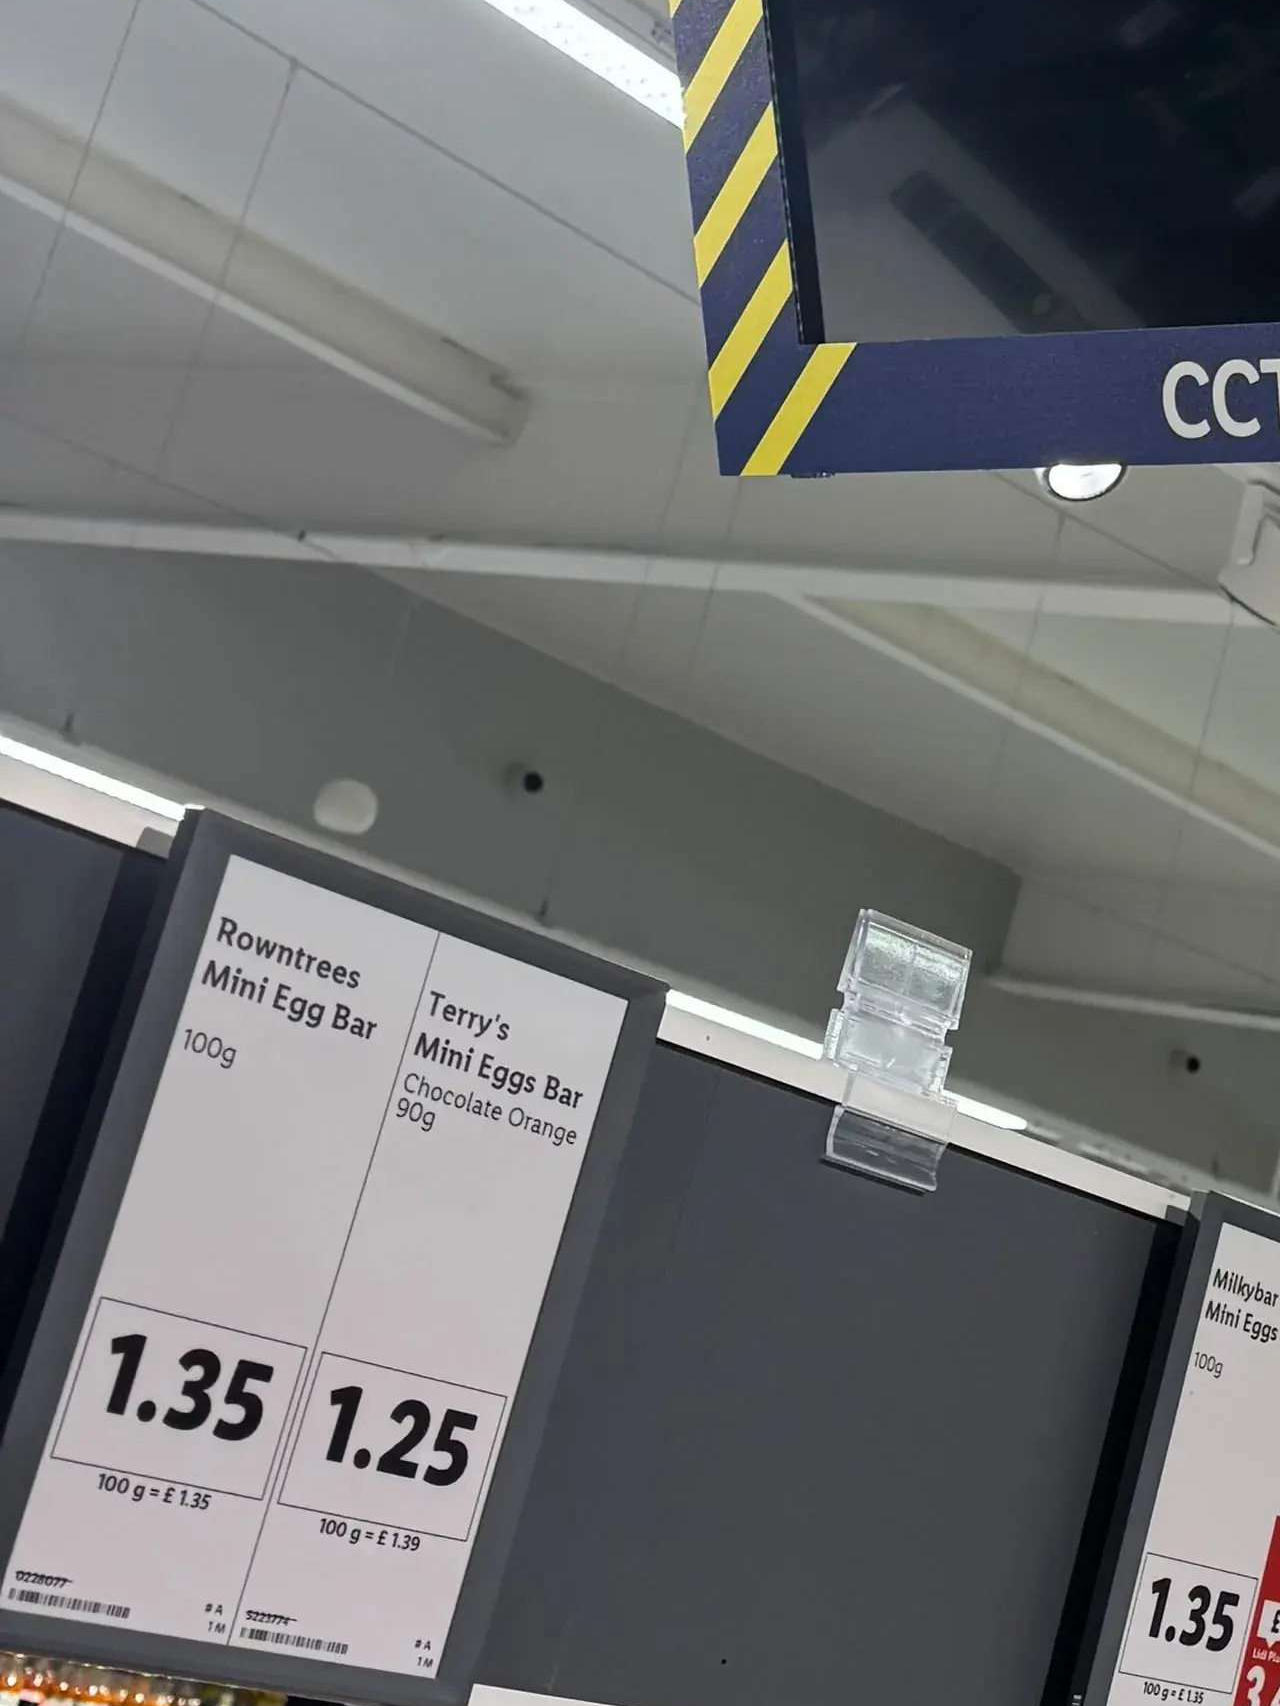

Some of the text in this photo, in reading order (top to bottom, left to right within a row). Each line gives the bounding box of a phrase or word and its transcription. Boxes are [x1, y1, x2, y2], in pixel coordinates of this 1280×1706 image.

[217, 917, 360, 989] Rowntrees
[201, 960, 377, 1040] Mini Egg Bar
[428, 991, 510, 1041] Terry's
[183, 1028, 237, 1069] 100g
[414, 1033, 583, 1109] Mini Eggs Bar
[395, 1098, 436, 1132] 90g
[403, 1073, 577, 1147] Chocolate Orange
[1212, 1268, 1279, 1308] Milkybar
[1205, 1300, 1279, 1343] Mini Eggs
[105, 1333, 274, 1441] 1.35
[1194, 1351, 1223, 1378] 100g
[325, 1385, 478, 1486] 1.25
[97, 1473, 212, 1511] 100 g = £ 1.35
[318, 1518, 421, 1553] 100 g = £ 1.39
[1149, 1577, 1240, 1652] 1.35
[1143, 1681, 1161, 1696] 100
